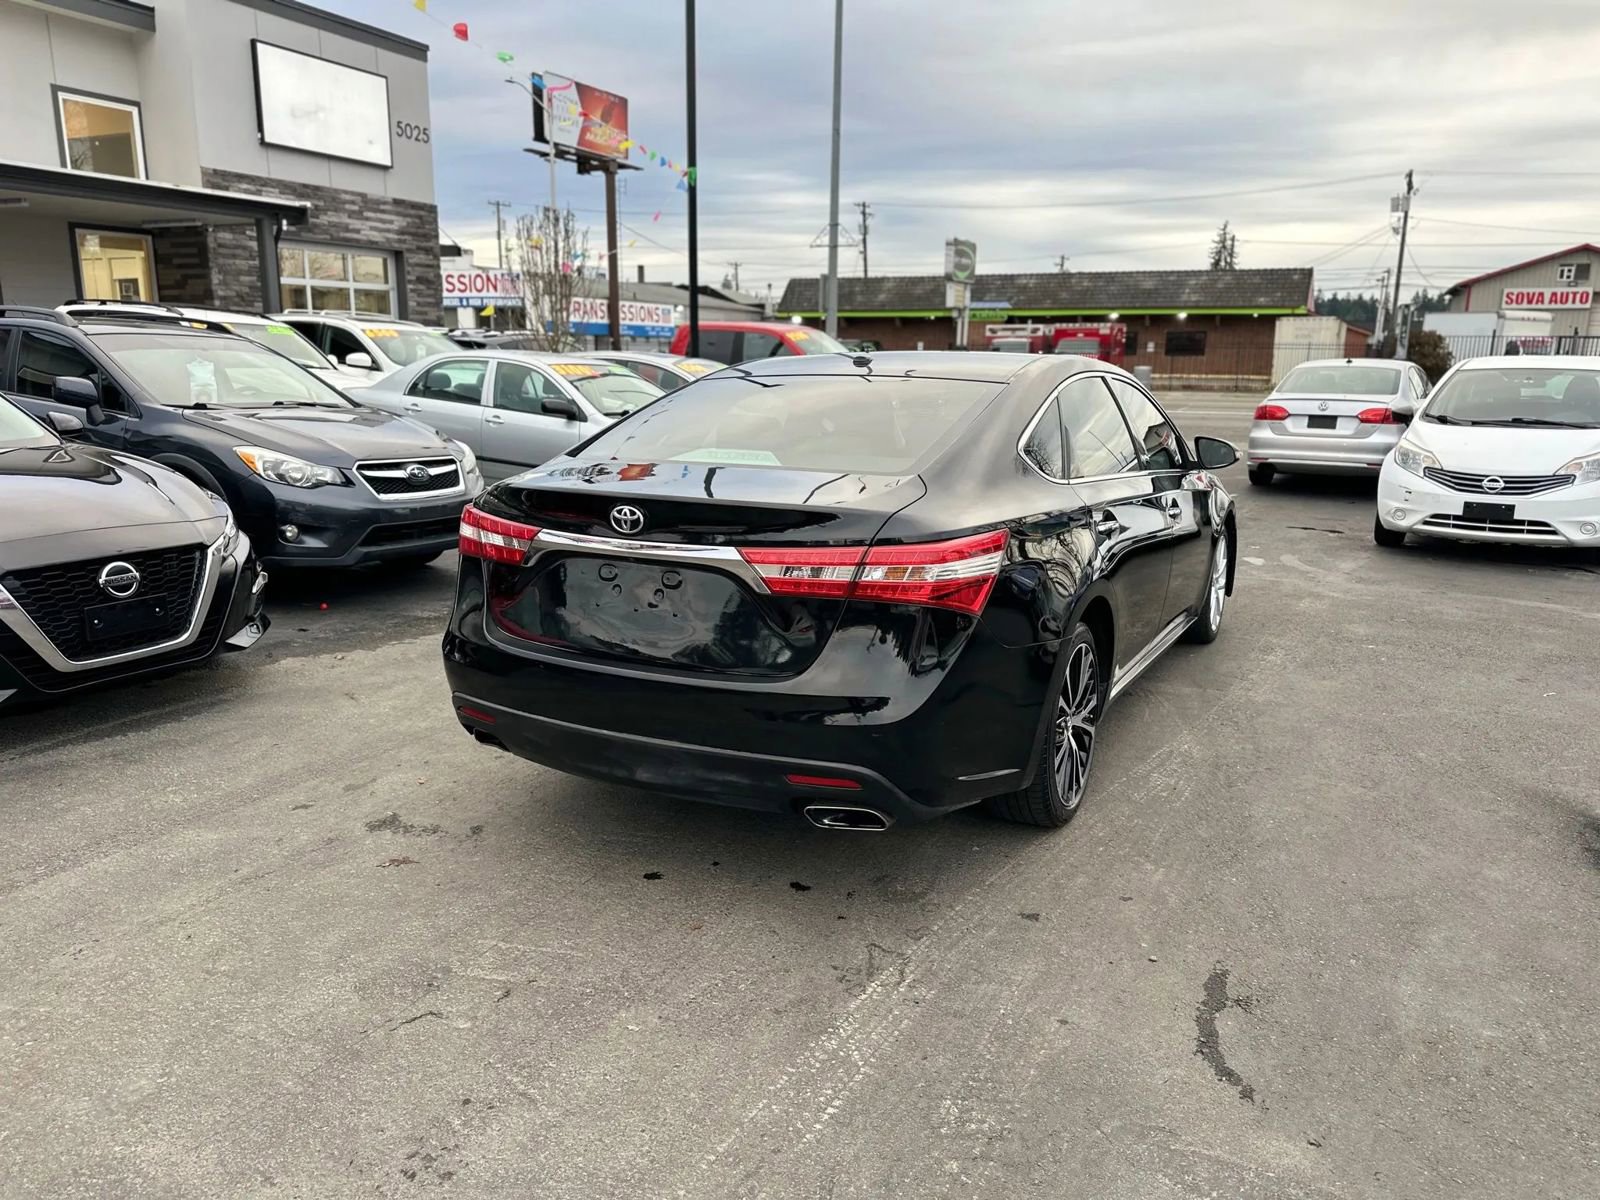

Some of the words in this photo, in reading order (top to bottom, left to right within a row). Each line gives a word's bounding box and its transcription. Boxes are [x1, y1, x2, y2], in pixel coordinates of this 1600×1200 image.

[396, 120, 430, 144] 5025
[1505, 291, 1545, 305] SOVA
[1548, 291, 1590, 305] AUTO
[104, 575, 136, 585] NISSAN
